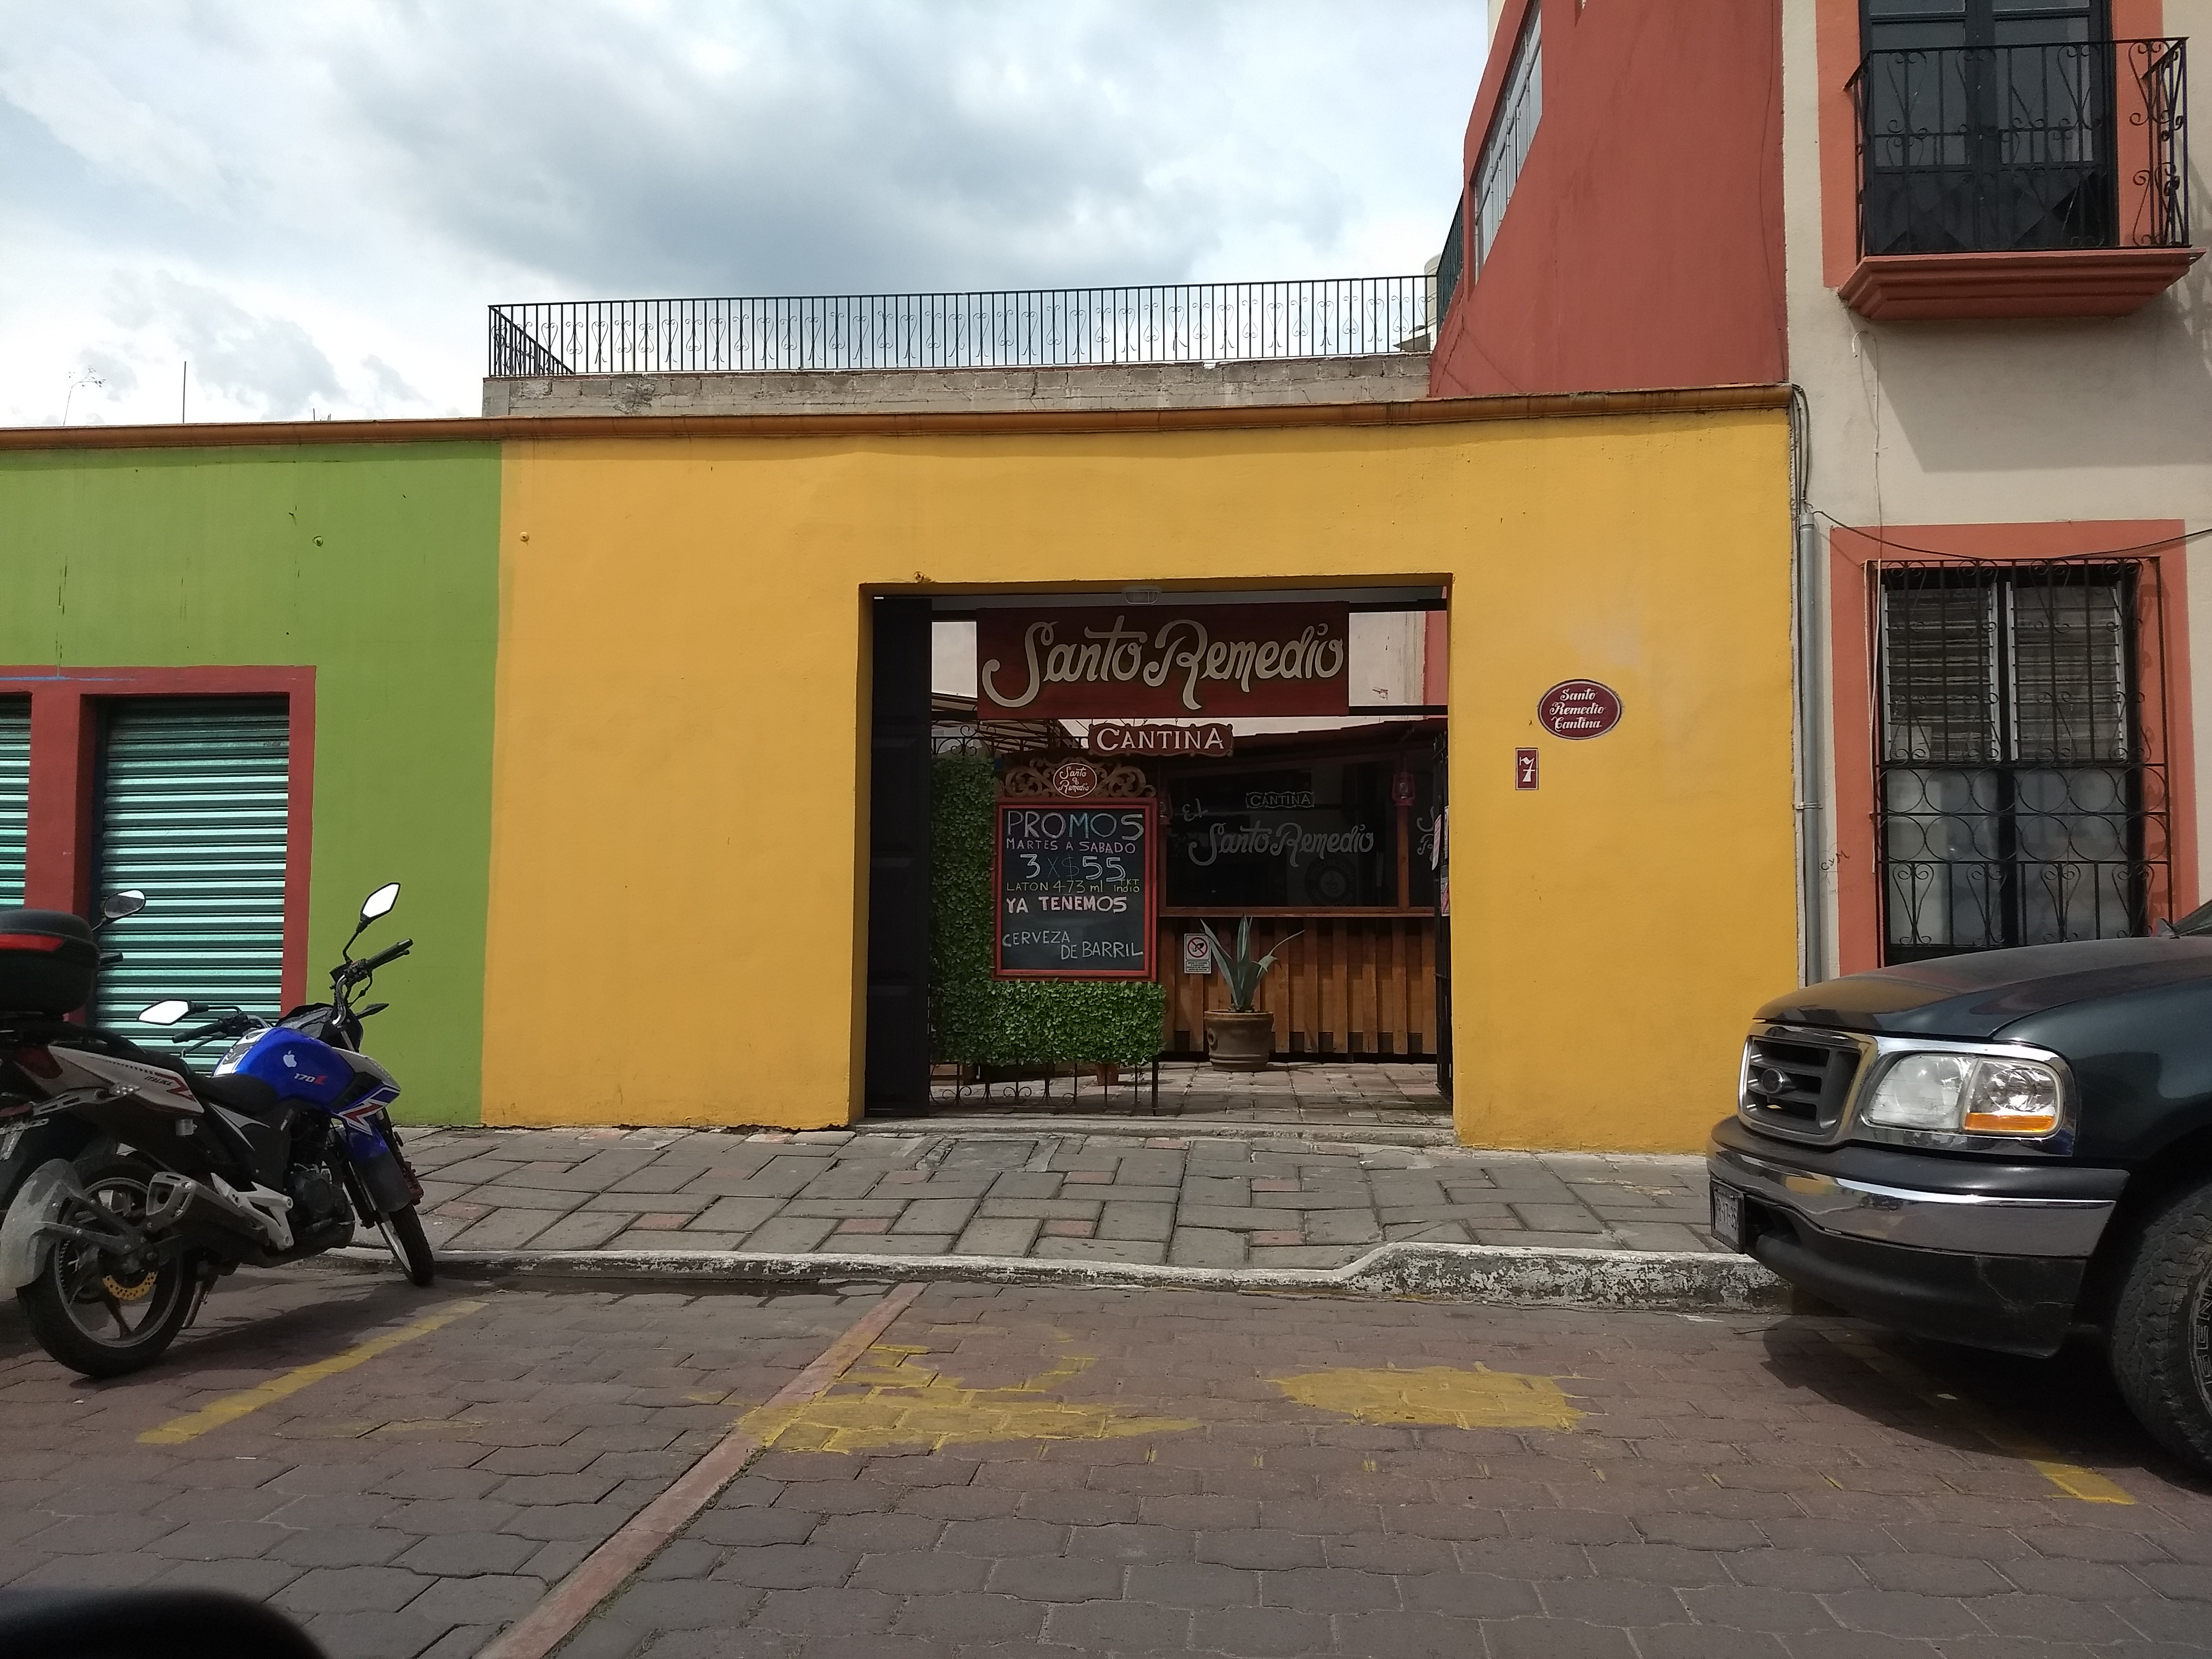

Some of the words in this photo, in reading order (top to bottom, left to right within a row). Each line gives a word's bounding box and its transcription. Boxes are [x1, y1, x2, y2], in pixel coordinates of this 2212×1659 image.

[982, 616, 1147, 708] Santo
[1143, 619, 1344, 710] Remedio
[1560, 688, 1598, 701] Santo
[1549, 702, 1606, 715] Remedio
[1551, 716, 1602, 732] Cantina
[1097, 726, 1226, 752] CANTINA
[1059, 766, 1087, 780] Santo
[1519, 757, 1536, 782] 7
[1058, 780, 1090, 794] Remedio
[1250, 793, 1311, 806] CANTINA
[1007, 810, 1144, 840] PROMOS
[1006, 838, 1058, 851] MARTES
[1066, 840, 1074, 850] A
[1079, 841, 1136, 854] SABADO
[1188, 820, 1272, 866] Santo
[1269, 822, 1374, 867] Remedio
[1020, 854, 1041, 878] 3
[1006, 881, 1049, 892] LATON
[1053, 880, 1086, 893] 473
[1090, 880, 1103, 893] ml
[1114, 884, 1140, 893] Indio
[1006, 898, 1029, 914] YA
[1038, 896, 1127, 913] TENEMOS
[1002, 930, 1070, 947] CERVEZA
[1060, 944, 1078, 960] DE
[1081, 941, 1144, 958] BARRIL
